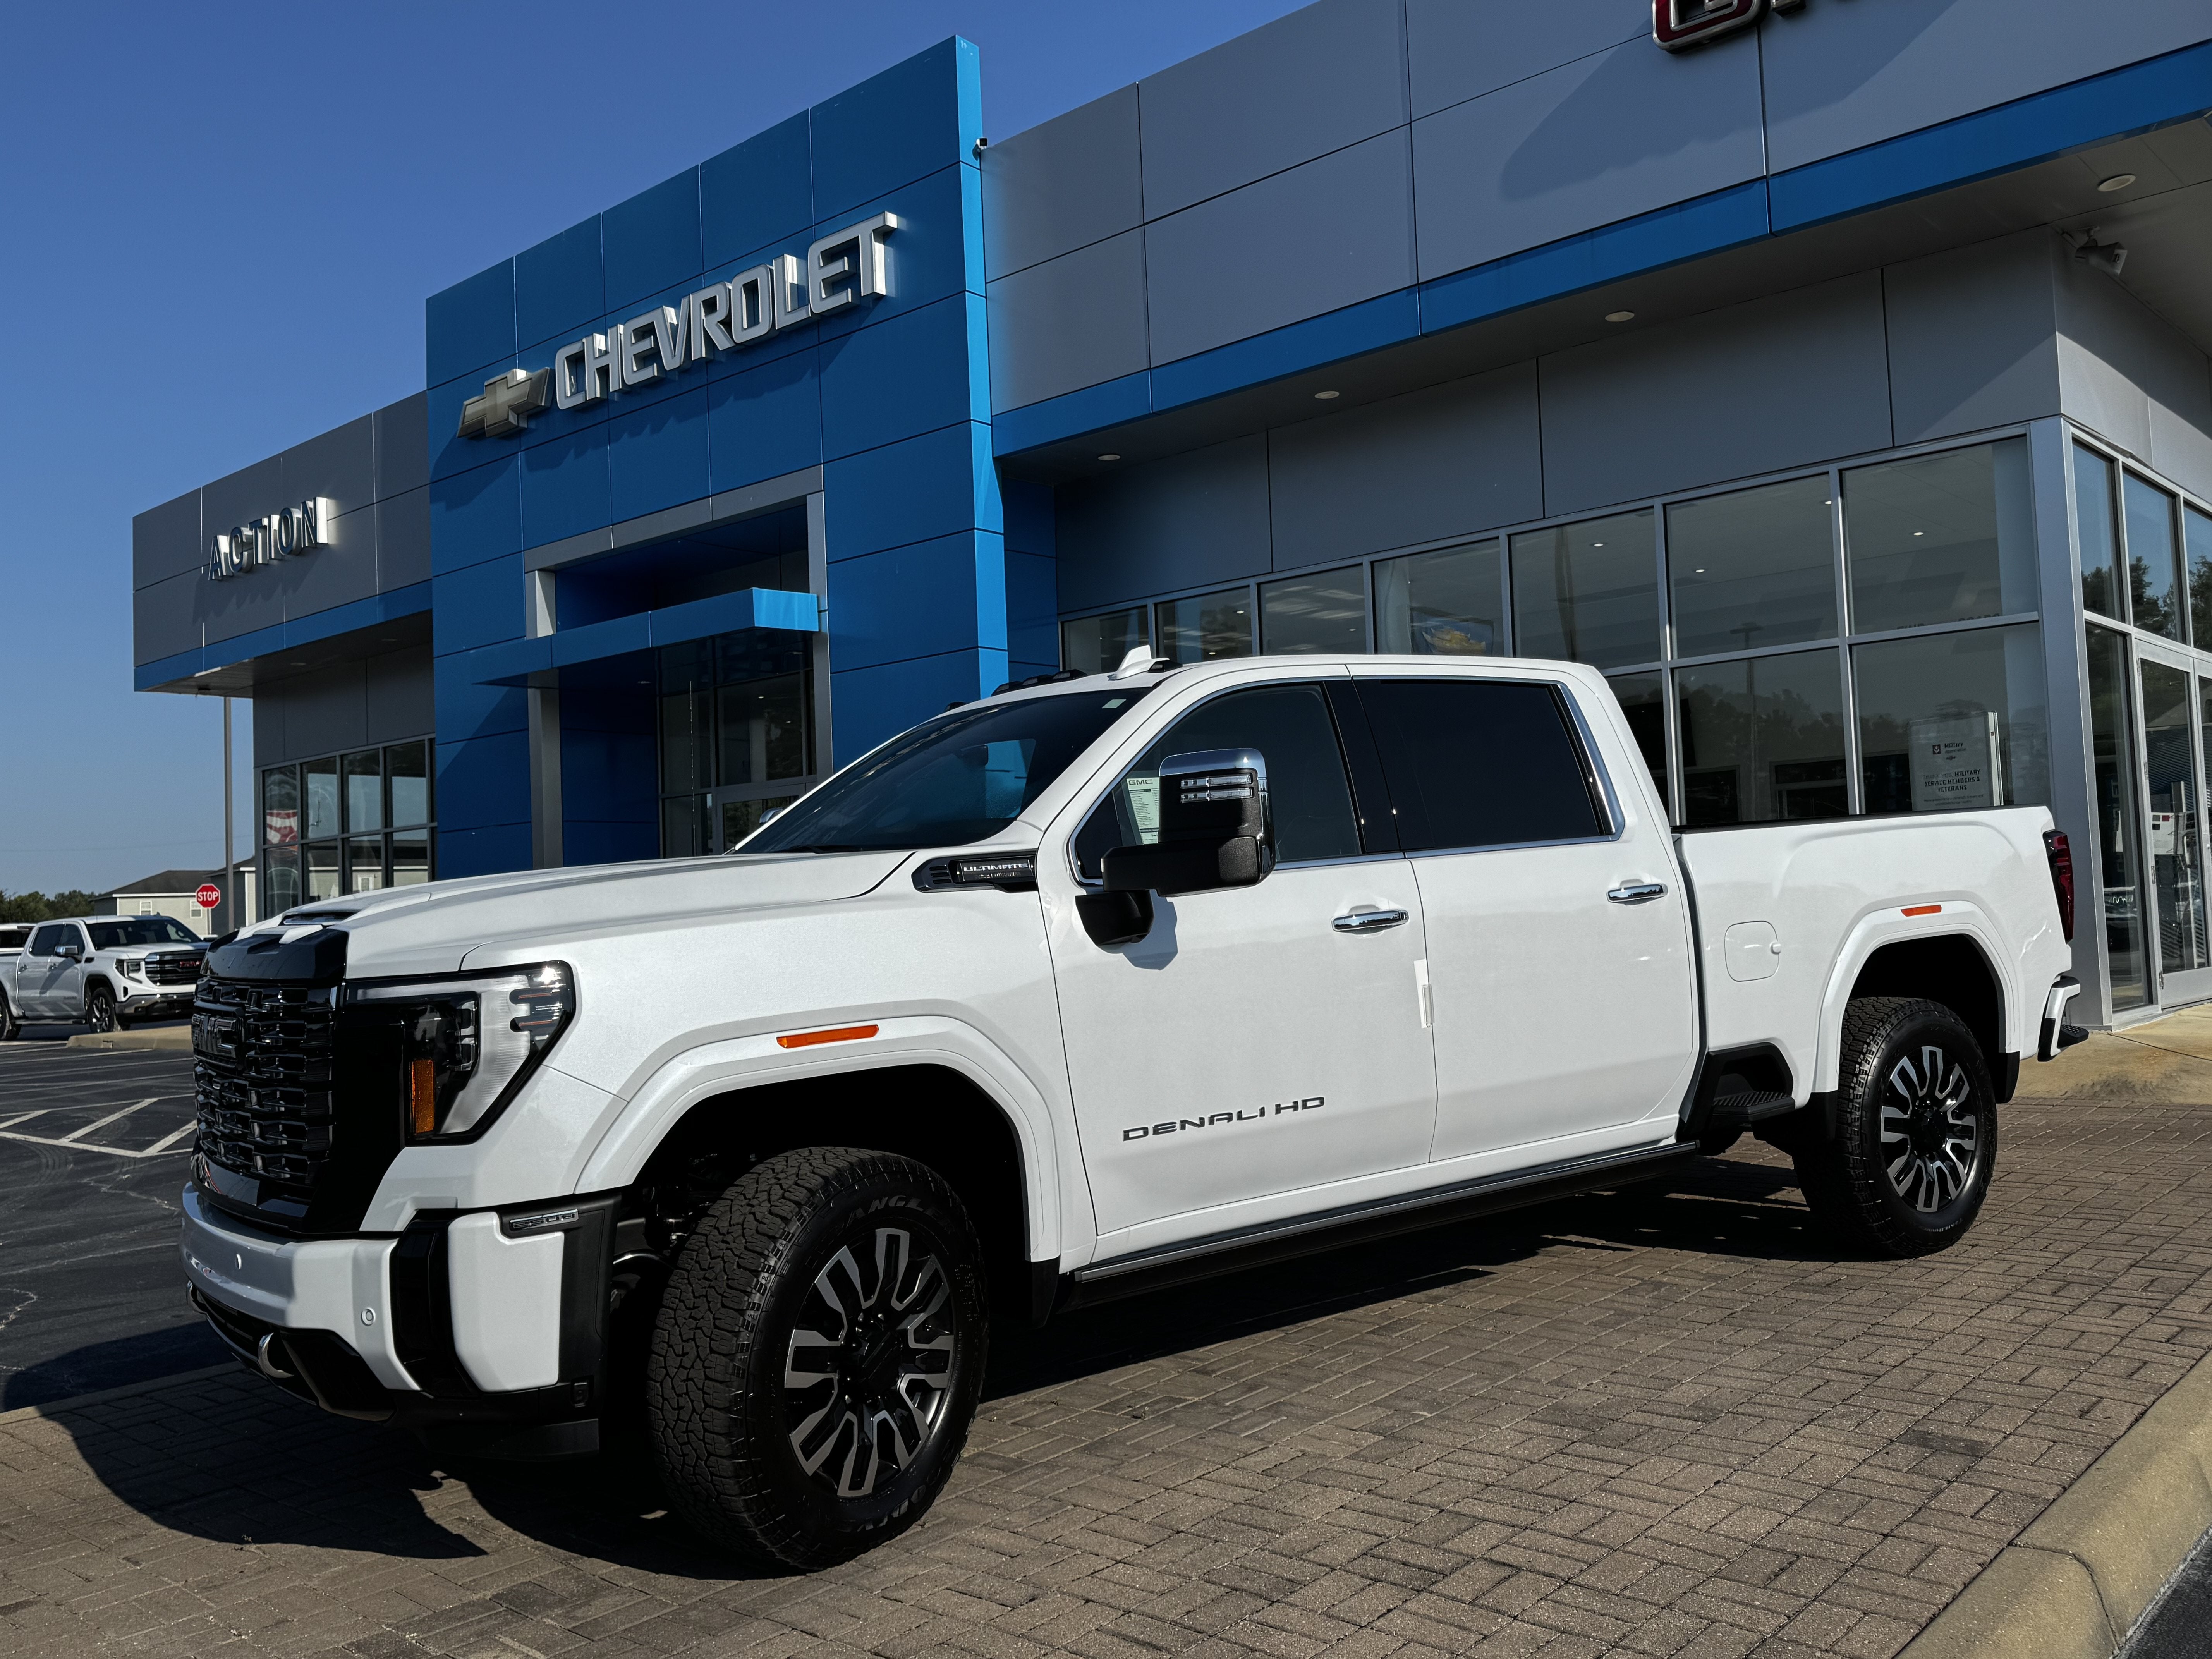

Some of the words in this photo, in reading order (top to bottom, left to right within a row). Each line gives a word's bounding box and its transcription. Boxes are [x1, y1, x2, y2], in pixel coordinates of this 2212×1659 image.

[555, 211, 898, 410] CHEVROLET
[208, 496, 328, 581] ACTION
[1937, 785, 1967, 793] VETERANS
[963, 863, 1029, 872] ULTIMATE
[198, 892, 218, 902] STOP
[1123, 1106, 1265, 1141] DENALI
[1275, 1096, 1325, 1115] HD
